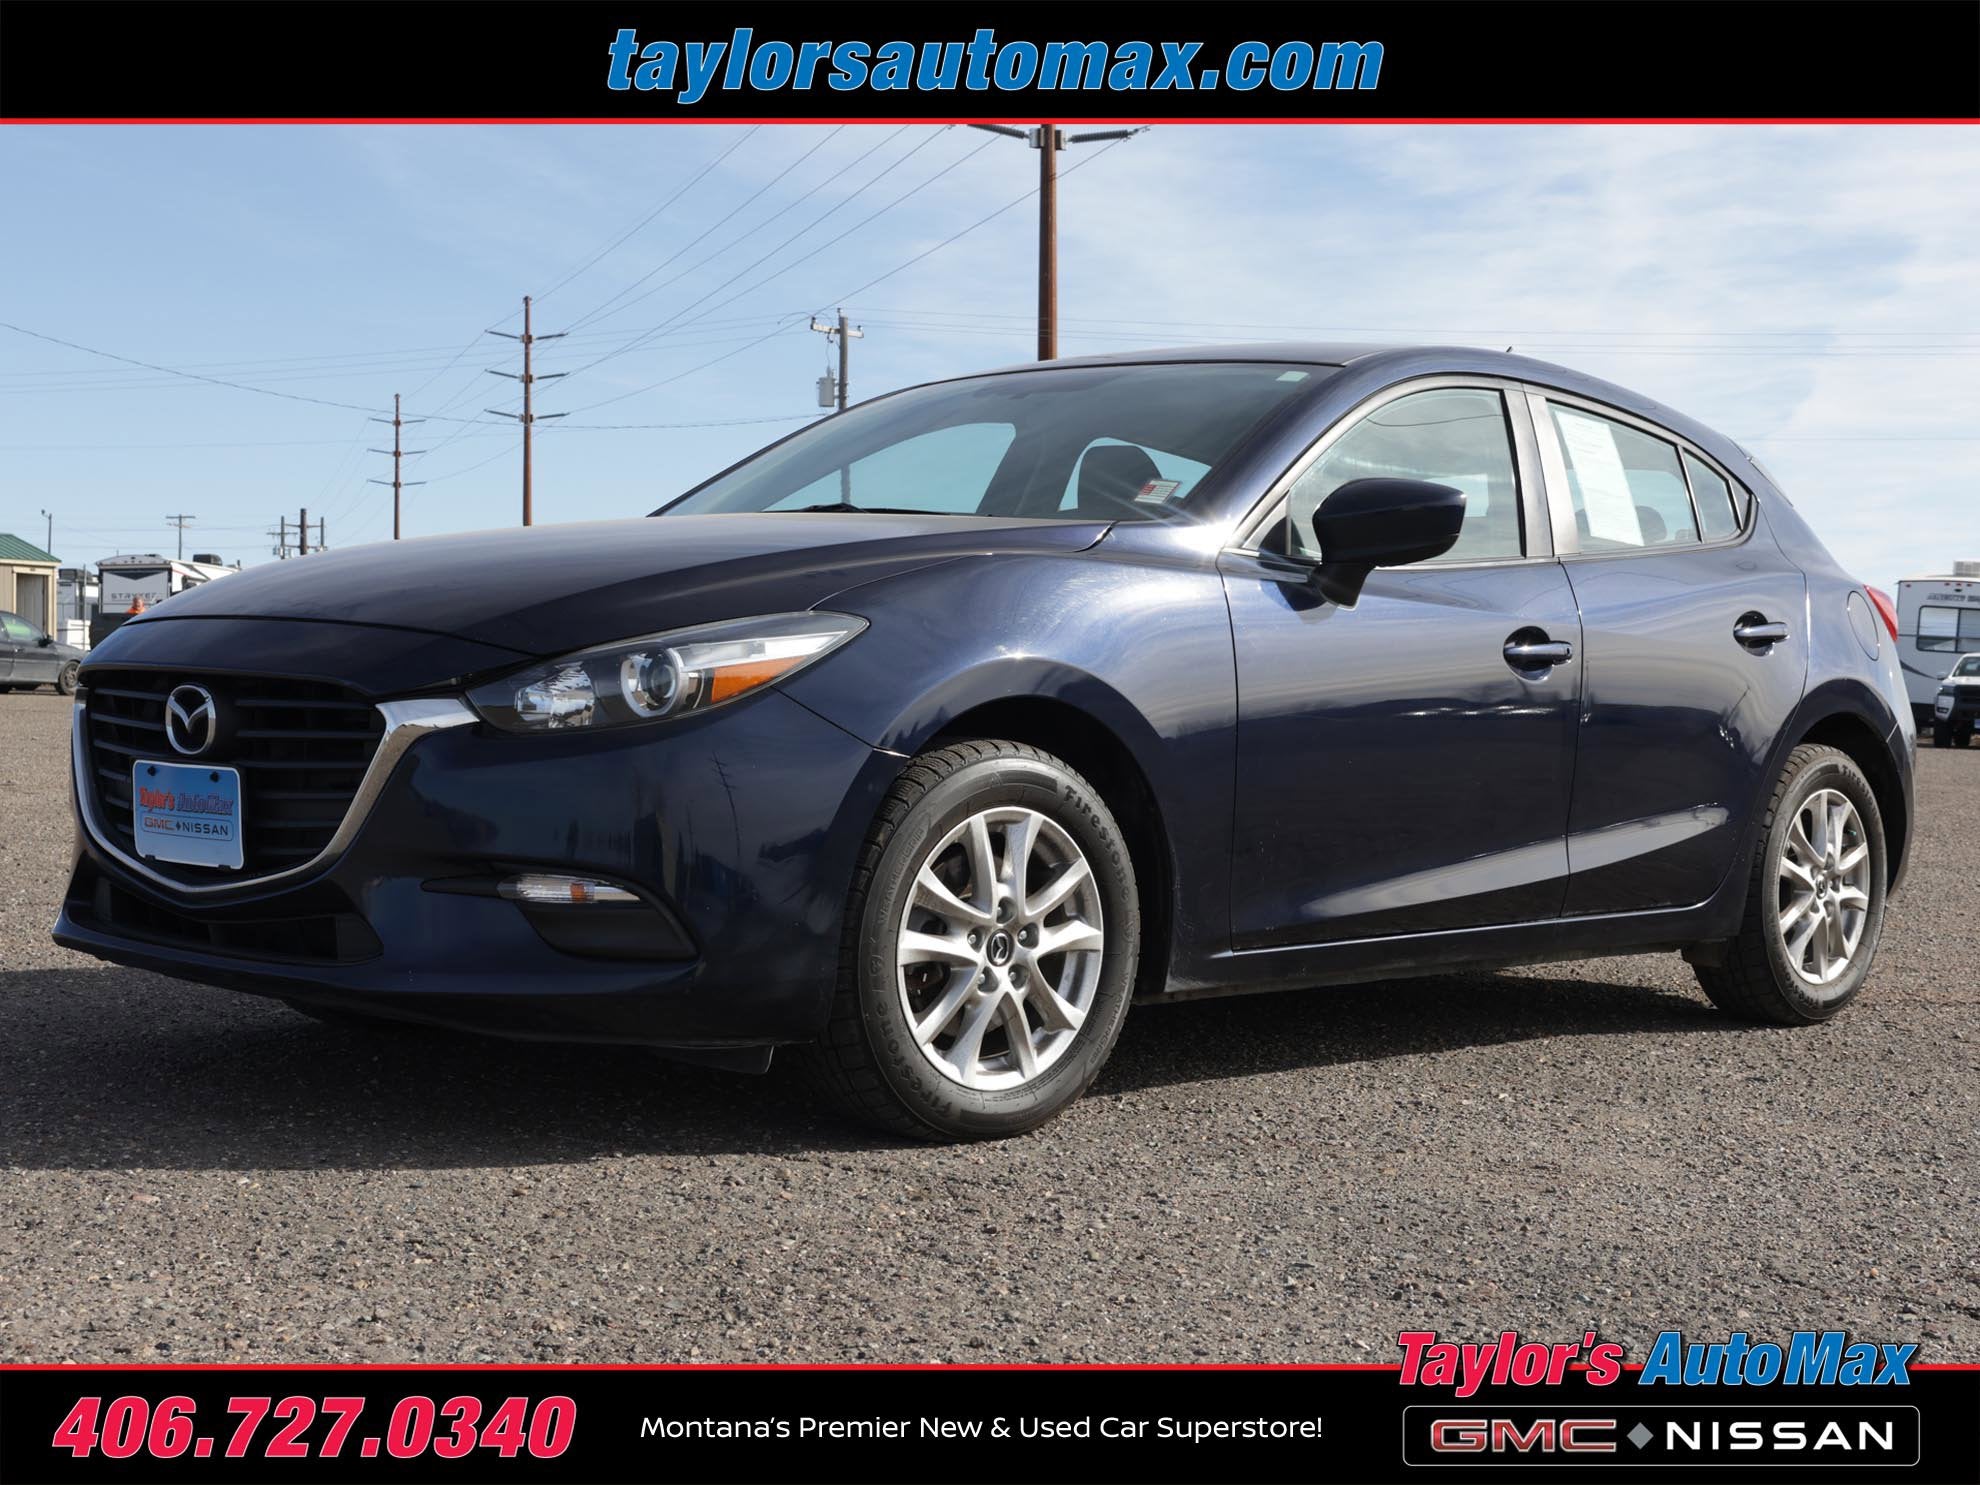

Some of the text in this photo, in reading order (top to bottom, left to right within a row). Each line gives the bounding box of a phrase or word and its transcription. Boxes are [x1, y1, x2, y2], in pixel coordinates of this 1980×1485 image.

[143, 817, 229, 836] GMC NISSAN
[1064, 784, 1130, 902] Firestone
